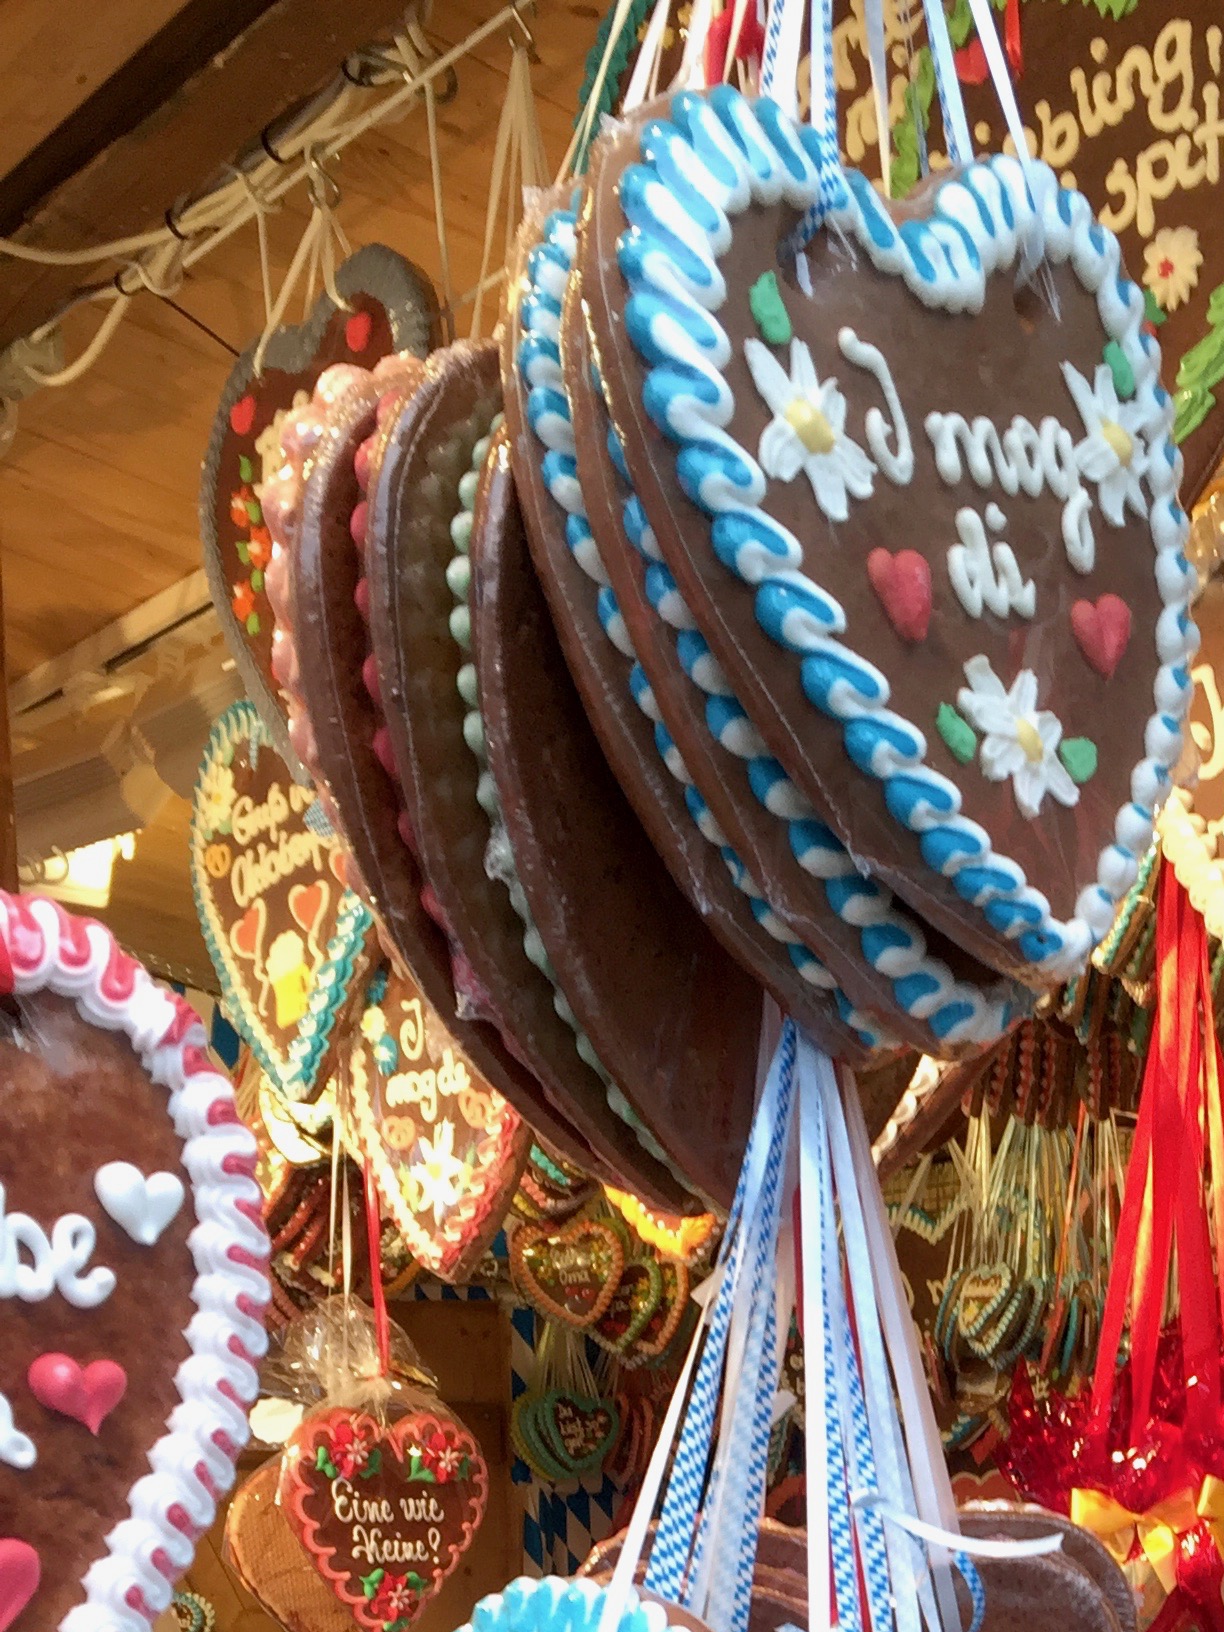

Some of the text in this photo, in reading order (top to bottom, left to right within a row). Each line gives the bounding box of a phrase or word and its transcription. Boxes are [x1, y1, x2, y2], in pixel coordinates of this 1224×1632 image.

[923, 409, 1096, 575] mog
[331, 1477, 445, 1523] Eine wie
